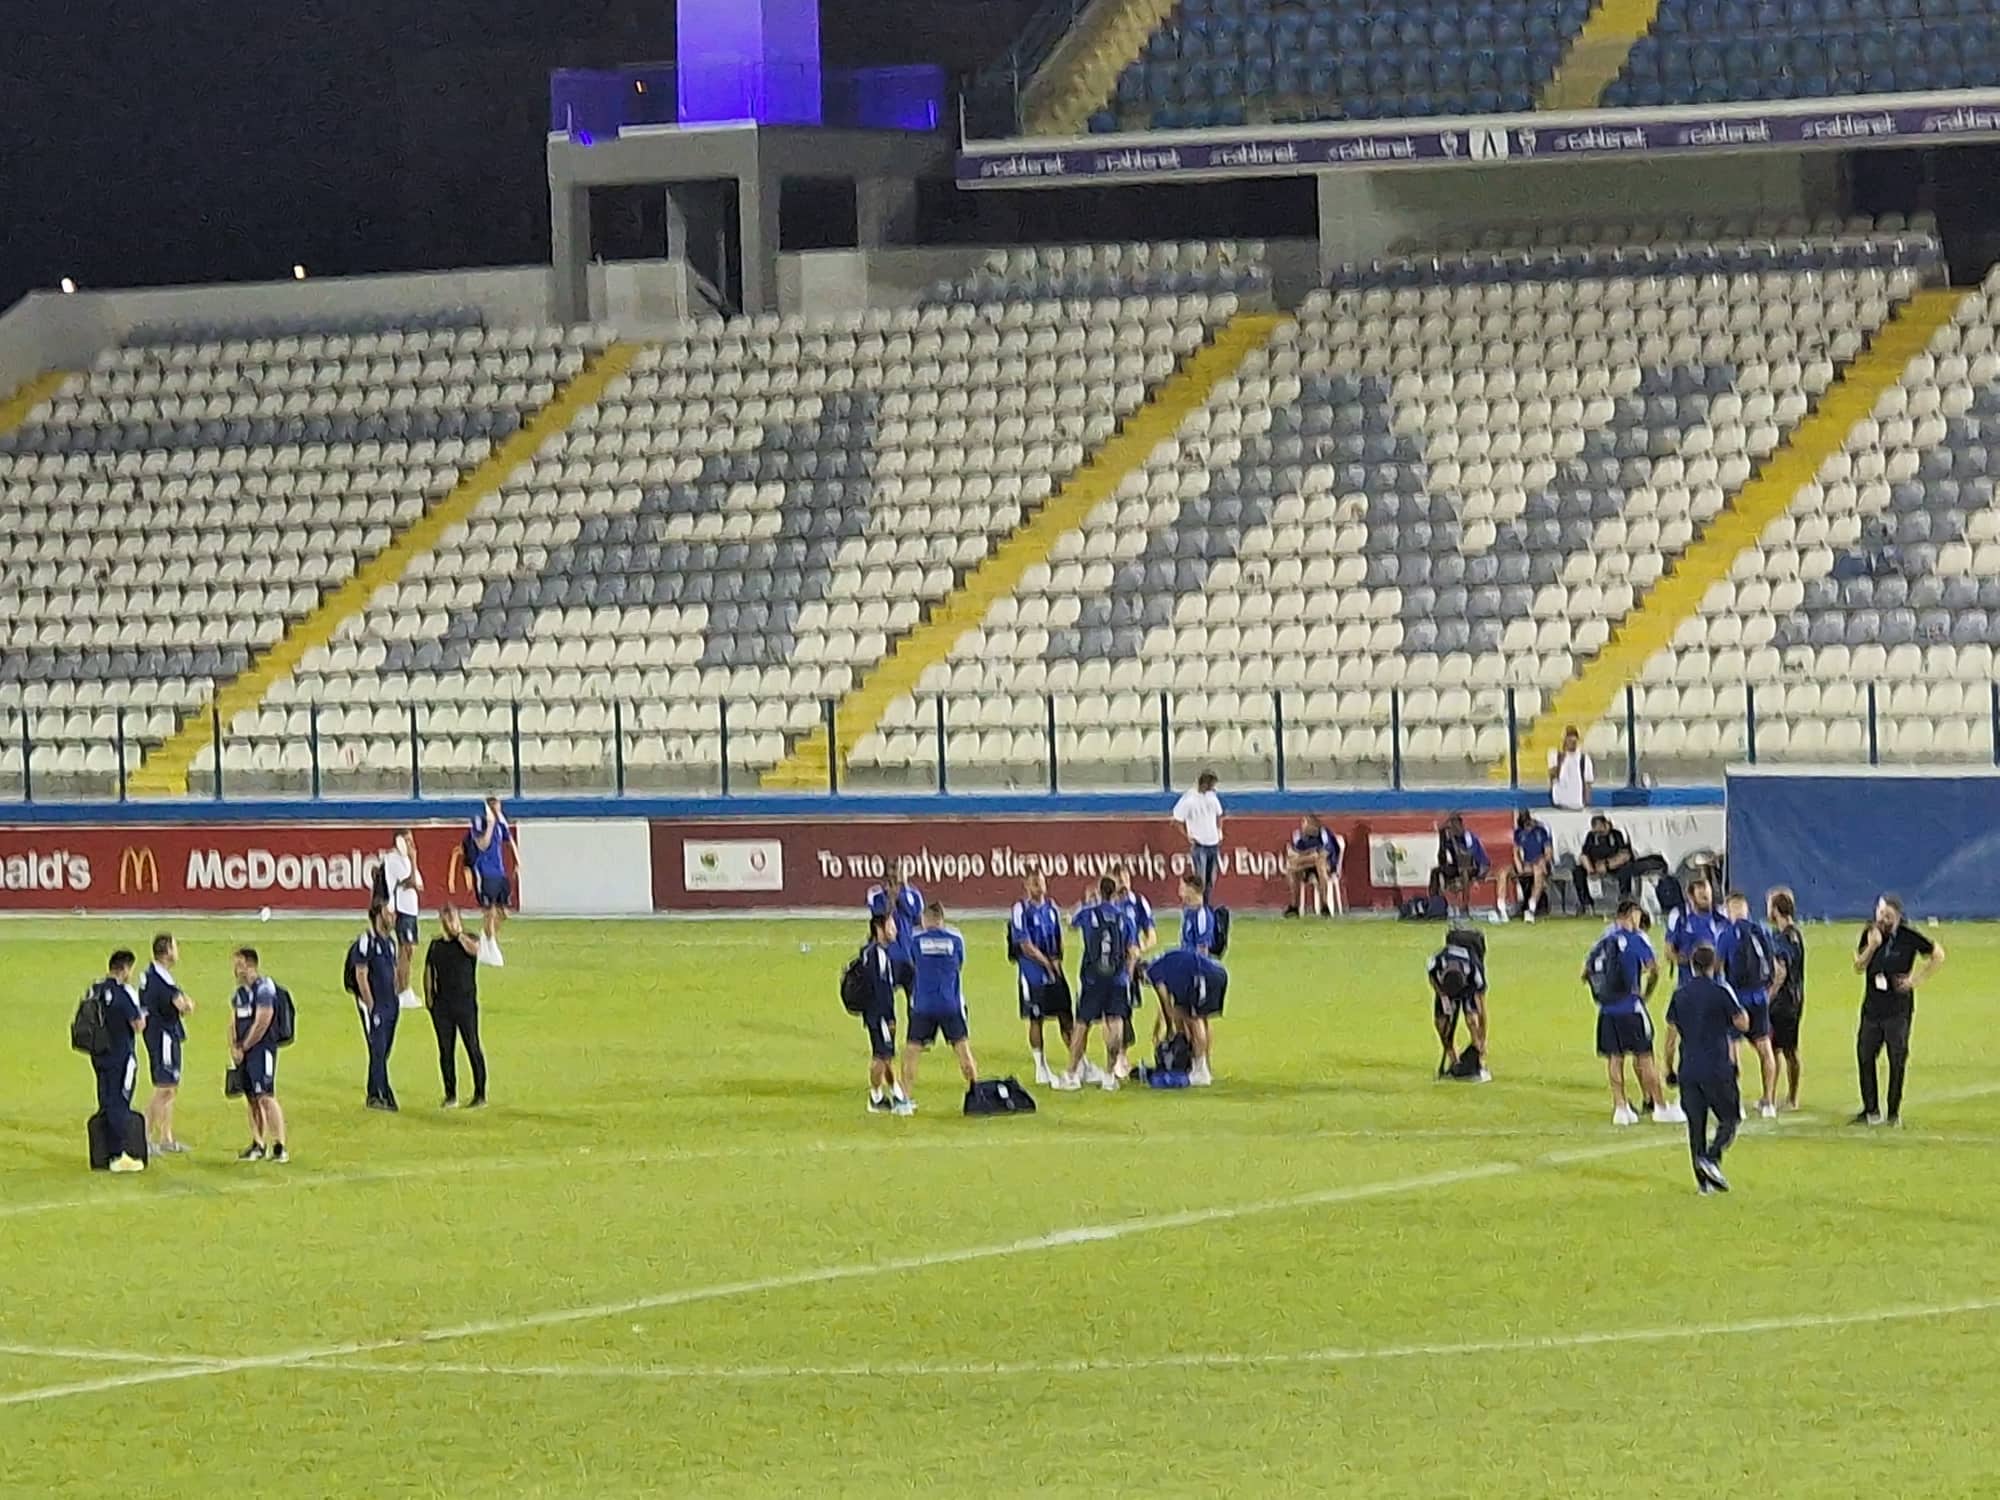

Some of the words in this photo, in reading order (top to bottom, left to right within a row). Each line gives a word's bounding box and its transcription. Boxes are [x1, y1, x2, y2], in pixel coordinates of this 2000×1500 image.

[0, 847, 92, 891] ald's
[817, 850, 842, 878] Το
[847, 854, 885, 878] πιο
